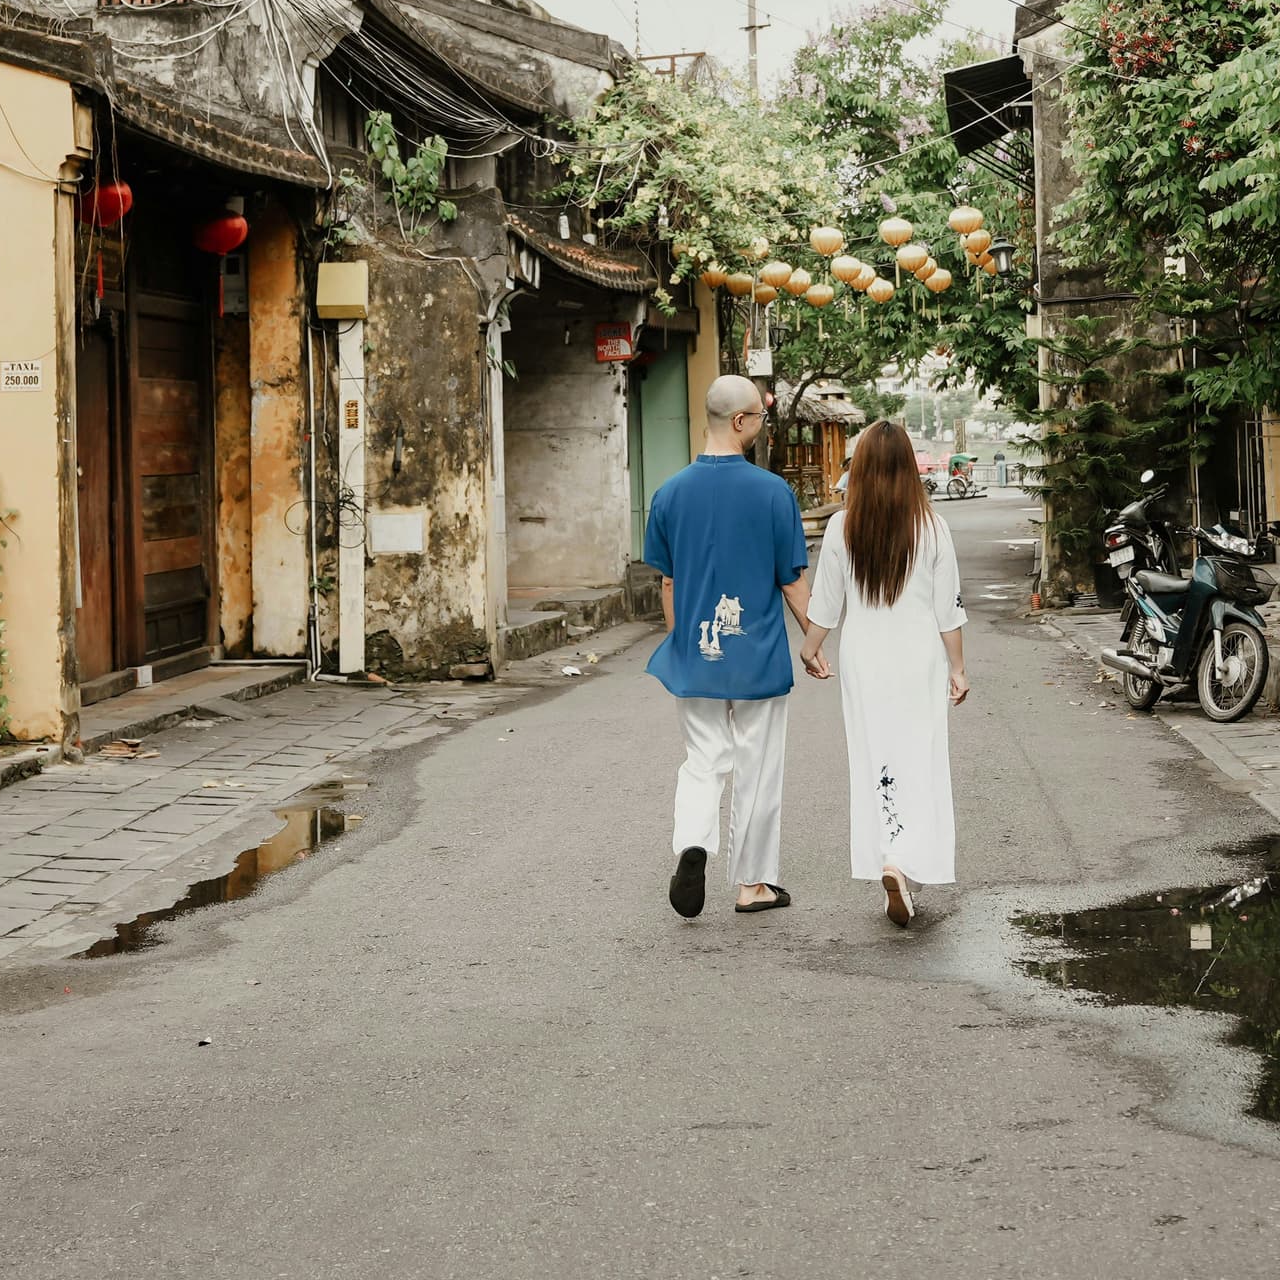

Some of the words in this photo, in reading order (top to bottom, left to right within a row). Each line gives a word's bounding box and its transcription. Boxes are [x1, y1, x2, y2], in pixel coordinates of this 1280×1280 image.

[597, 344, 620, 352] NORTH
[9, 363, 34, 371] TAXI
[5, 375, 39, 385] 250.000
